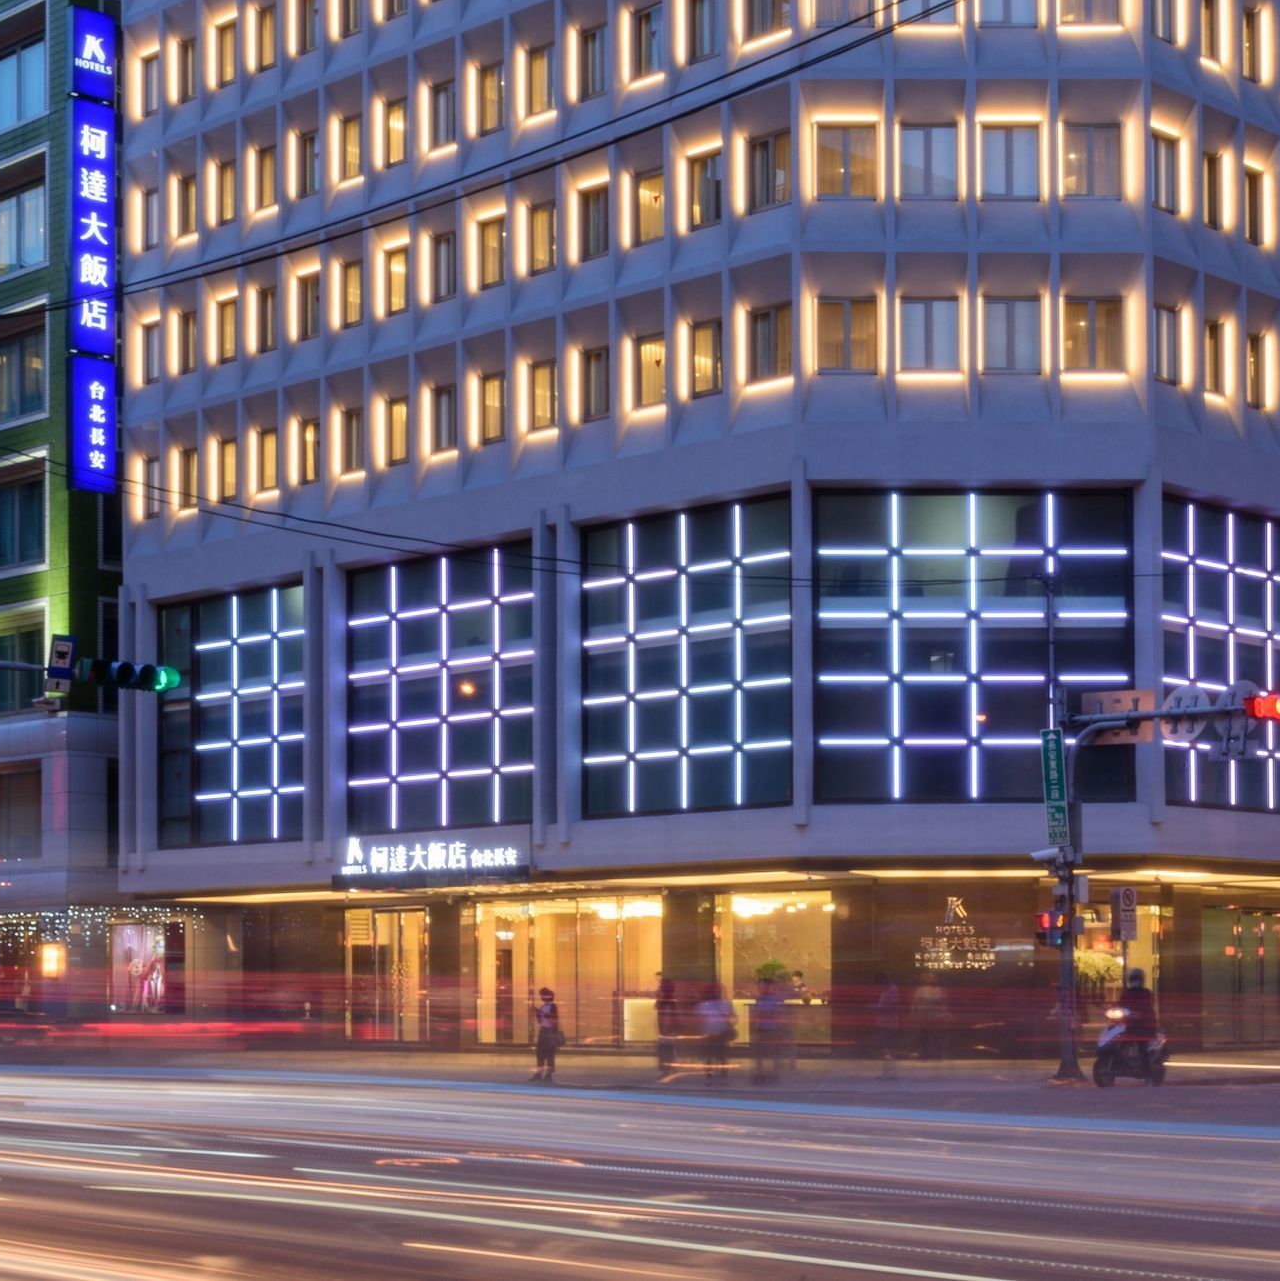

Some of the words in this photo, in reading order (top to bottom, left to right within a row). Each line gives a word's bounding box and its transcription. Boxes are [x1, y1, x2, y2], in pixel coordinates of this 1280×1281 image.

[75, 57, 113, 76] HOTELS
[79, 123, 109, 331] 柯達大飯店
[88, 380, 106, 469] 台北長安
[371, 841, 467, 873] 柯達大飯店
[935, 925, 975, 936] HOTELS
